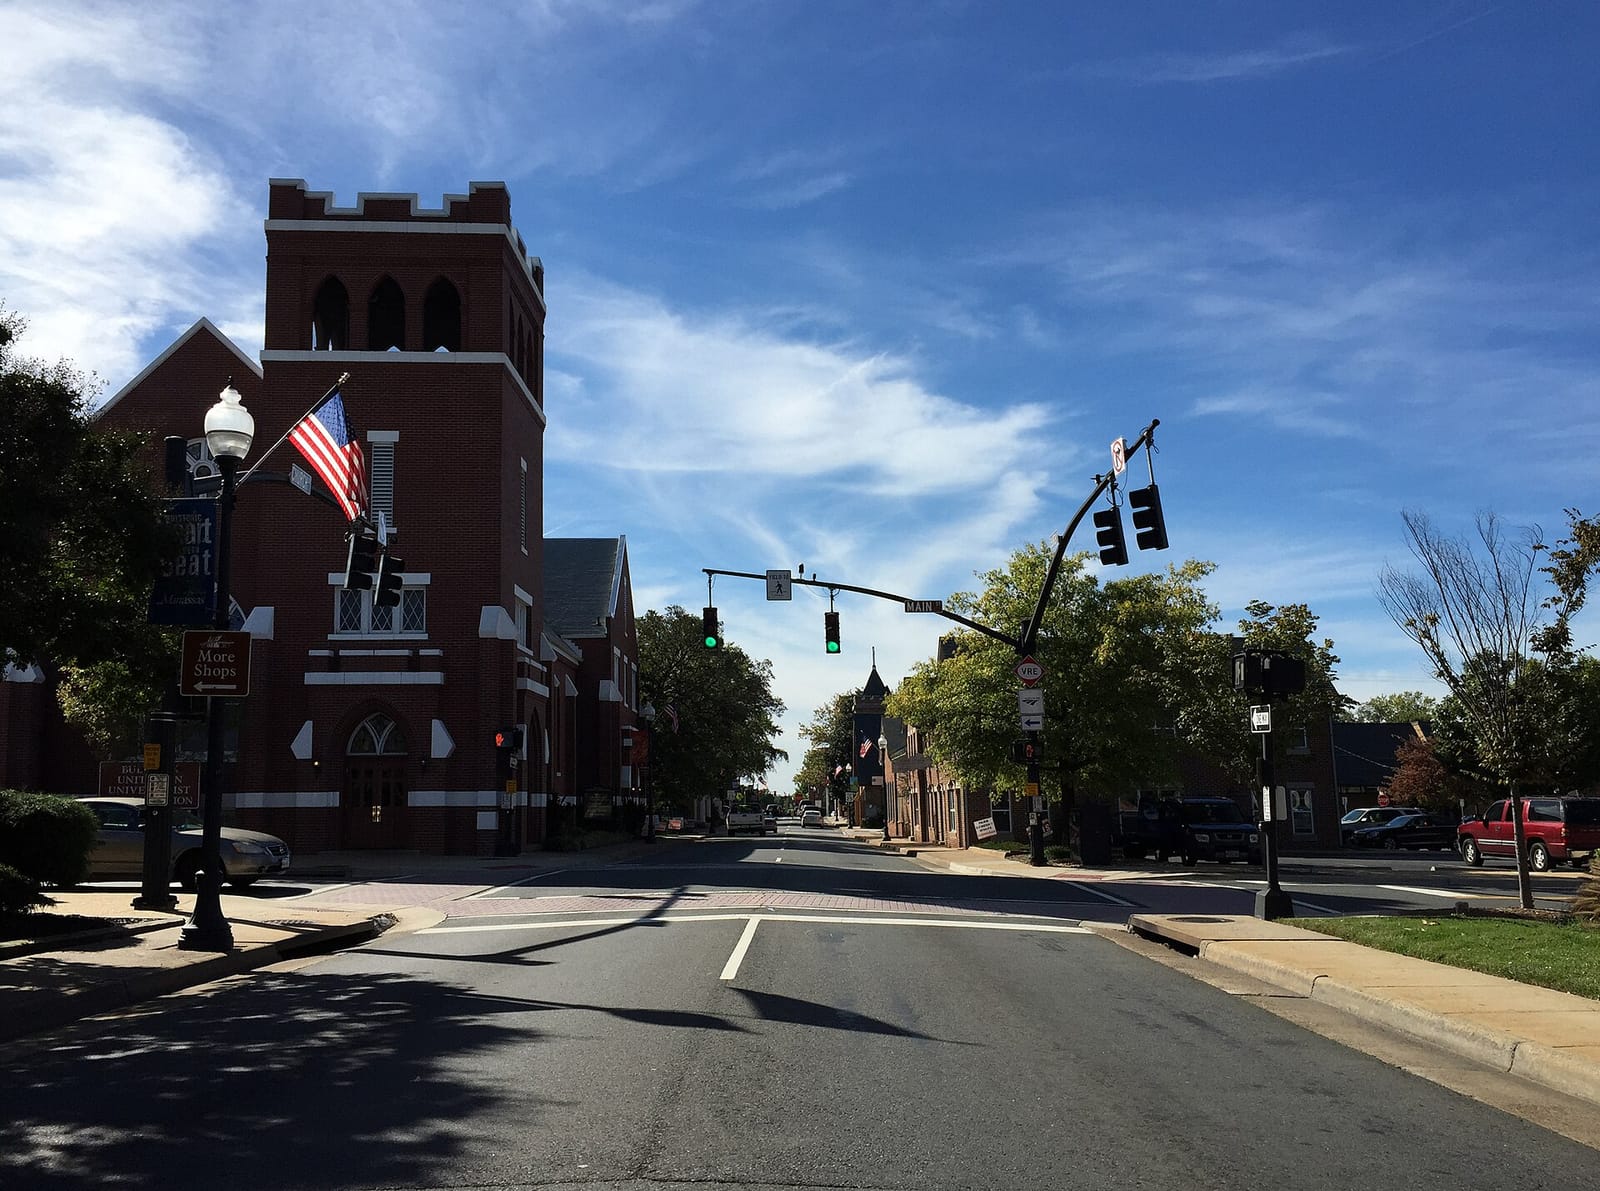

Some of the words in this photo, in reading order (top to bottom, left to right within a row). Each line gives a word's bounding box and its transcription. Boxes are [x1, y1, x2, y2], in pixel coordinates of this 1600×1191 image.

[907, 601, 932, 611] MAIN
[197, 649, 235, 663] More
[193, 663, 237, 680] Shops
[1021, 667, 1038, 676] VRE
[121, 764, 144, 774] BUL
